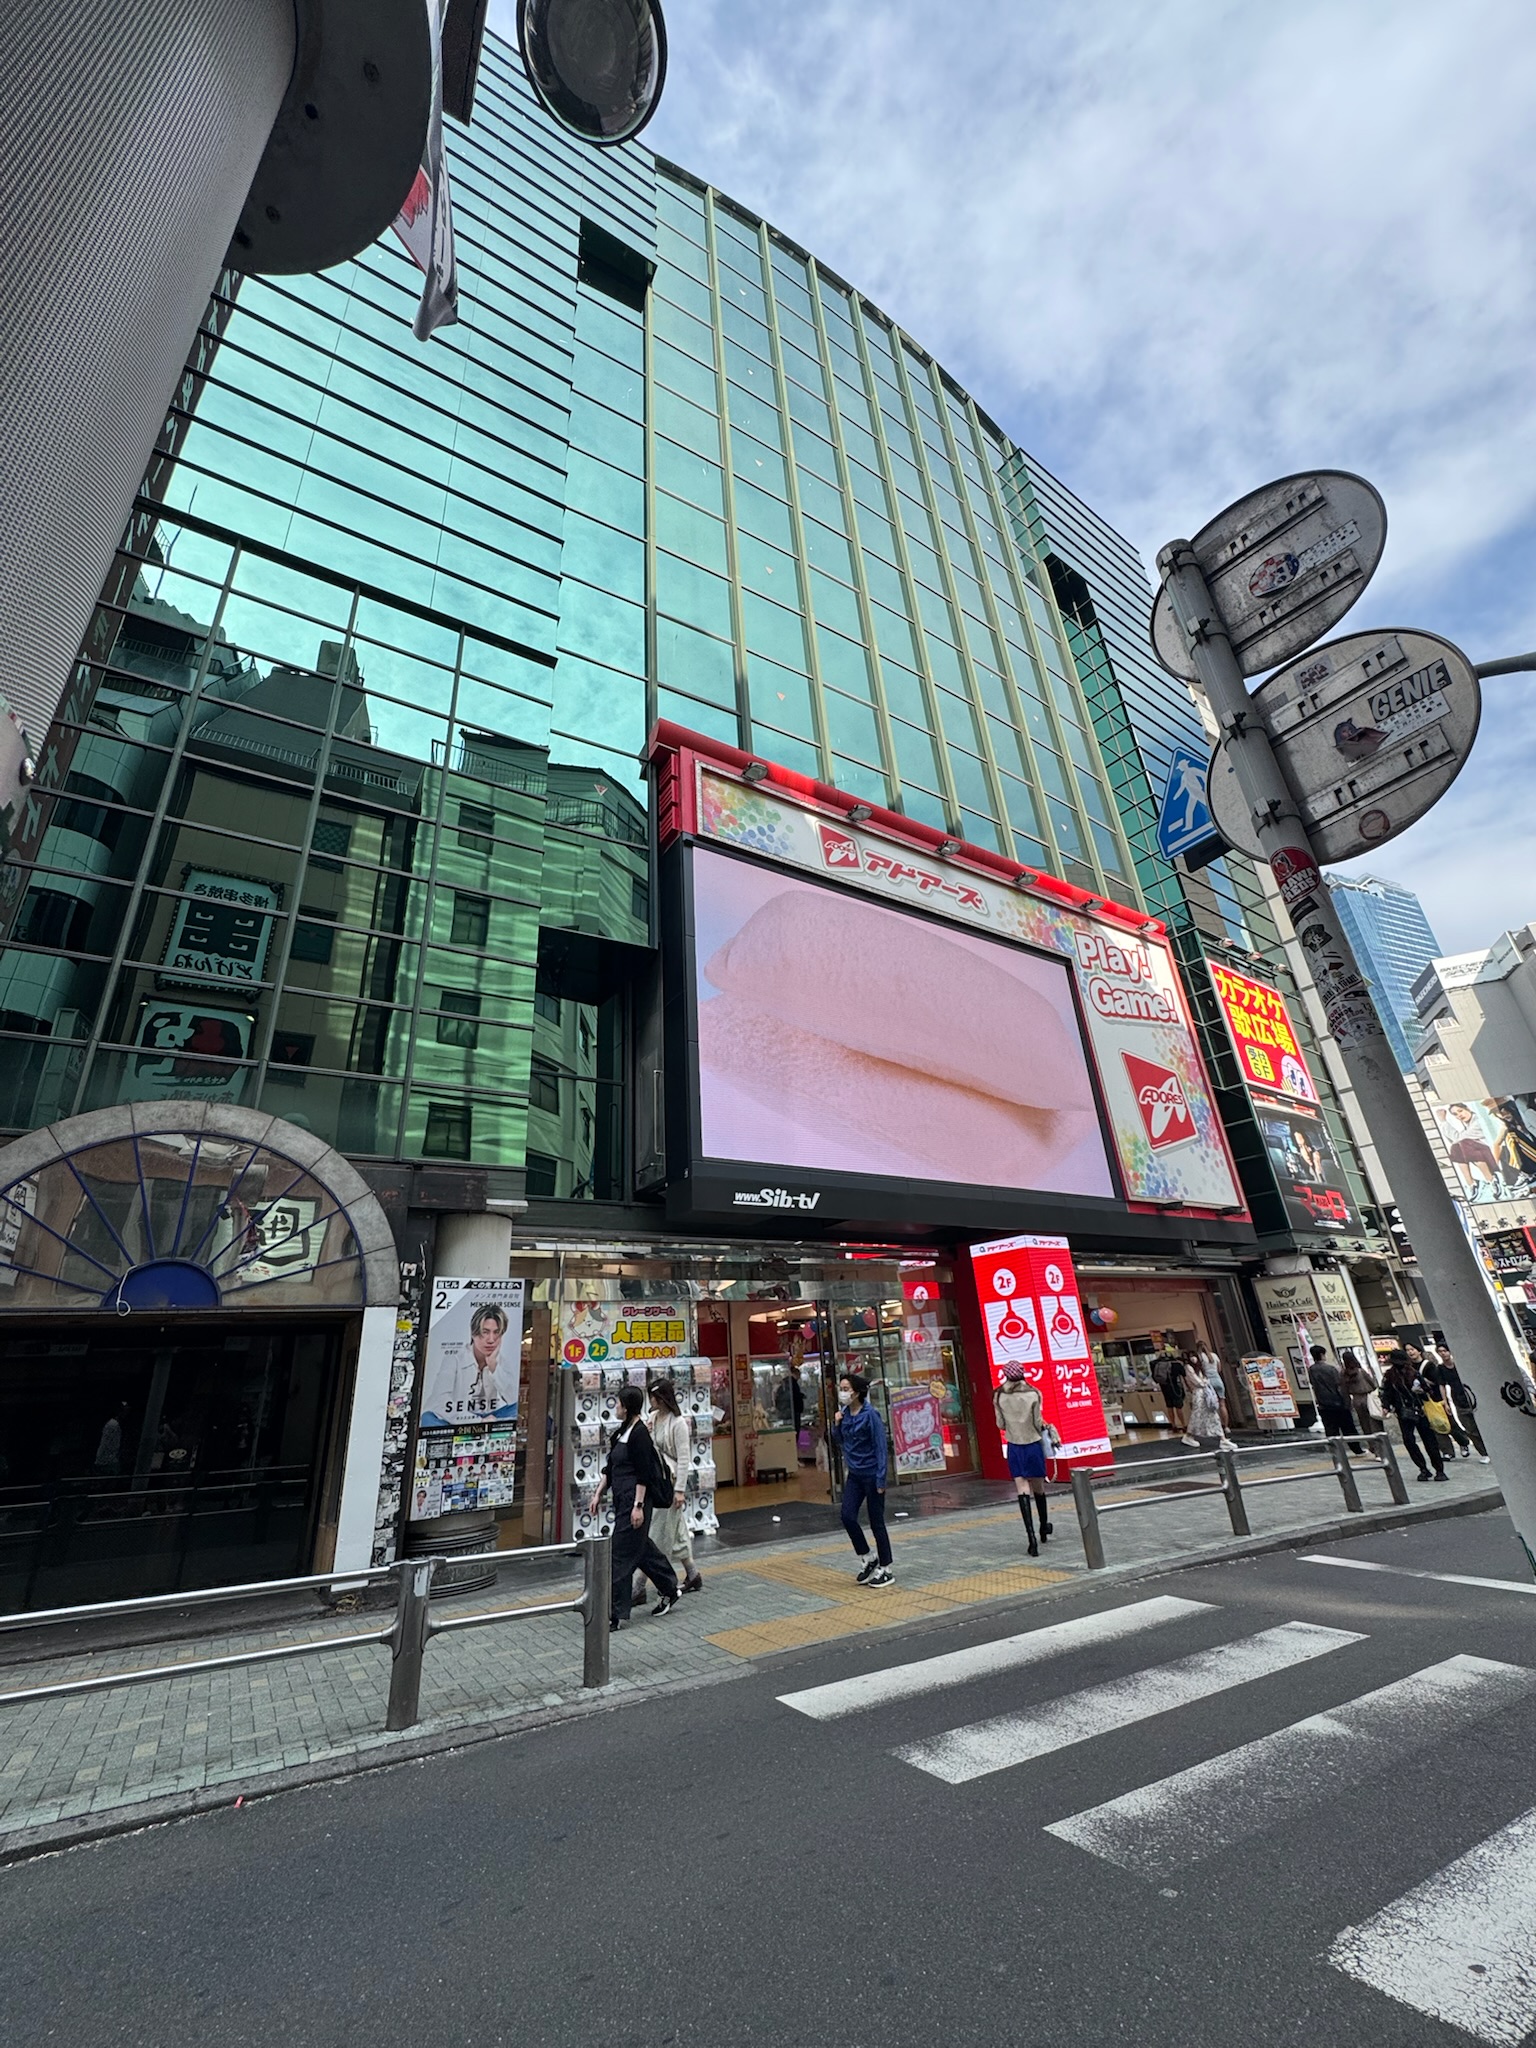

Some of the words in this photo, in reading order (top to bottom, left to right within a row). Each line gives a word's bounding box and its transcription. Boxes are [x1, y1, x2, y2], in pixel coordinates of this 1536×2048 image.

[1371, 659, 1449, 722] GENIE
[865, 851, 983, 910] アドアーズ
[1284, 876, 1316, 902] REDS
[1074, 931, 1152, 983] Play!
[1089, 977, 1180, 1024] Game!
[1215, 969, 1283, 1020] カラオケ
[1227, 1002, 1297, 1056] 歌広場
[1247, 1046, 1268, 1065] 受付
[1253, 1062, 1270, 1078] 5F
[1142, 1090, 1183, 1105] ADORES
[733, 1188, 820, 1210] www.Sib.tv
[998, 1276, 1012, 1289] 2F
[1049, 1271, 1060, 1284] 2F
[434, 1291, 452, 1309] 2F
[623, 1306, 676, 1317] クレーンゲーム
[568, 1345, 582, 1358] 1F
[591, 1343, 606, 1357] 2F
[998, 1367, 1043, 1384] クーン
[1056, 1364, 1090, 1380] クレーン
[1063, 1382, 1091, 1399] ゲーム
[445, 1399, 498, 1413] SENSE
